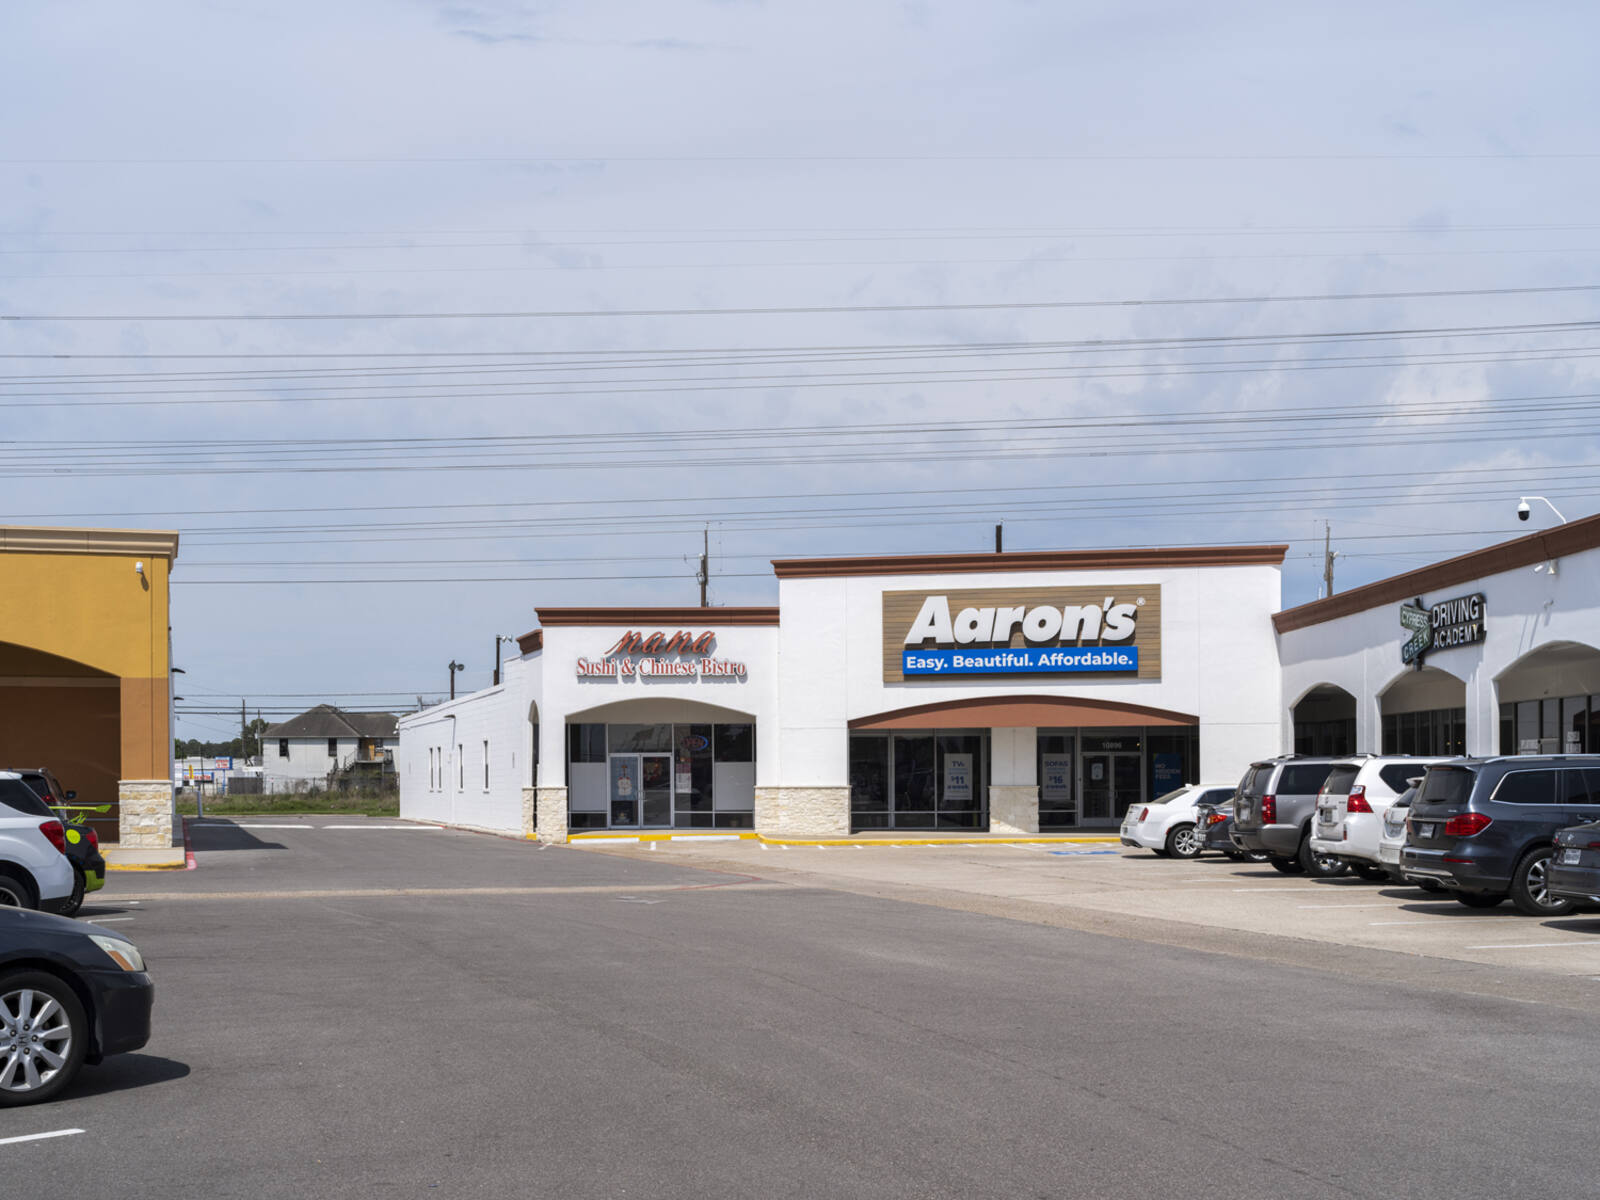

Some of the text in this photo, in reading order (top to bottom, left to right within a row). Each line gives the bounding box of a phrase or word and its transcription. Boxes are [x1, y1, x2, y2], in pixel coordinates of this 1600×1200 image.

[904, 595, 1137, 644] Aaron's
[1401, 610, 1429, 629] CYPRESS
[1432, 596, 1479, 628] DRIVING
[1403, 632, 1429, 659] CREEK
[1433, 624, 1478, 648] ACADEMY
[576, 657, 746, 675] Sushi & Chinese Bistro
[906, 652, 1133, 671] Easy. Beautiful. Affordable.
